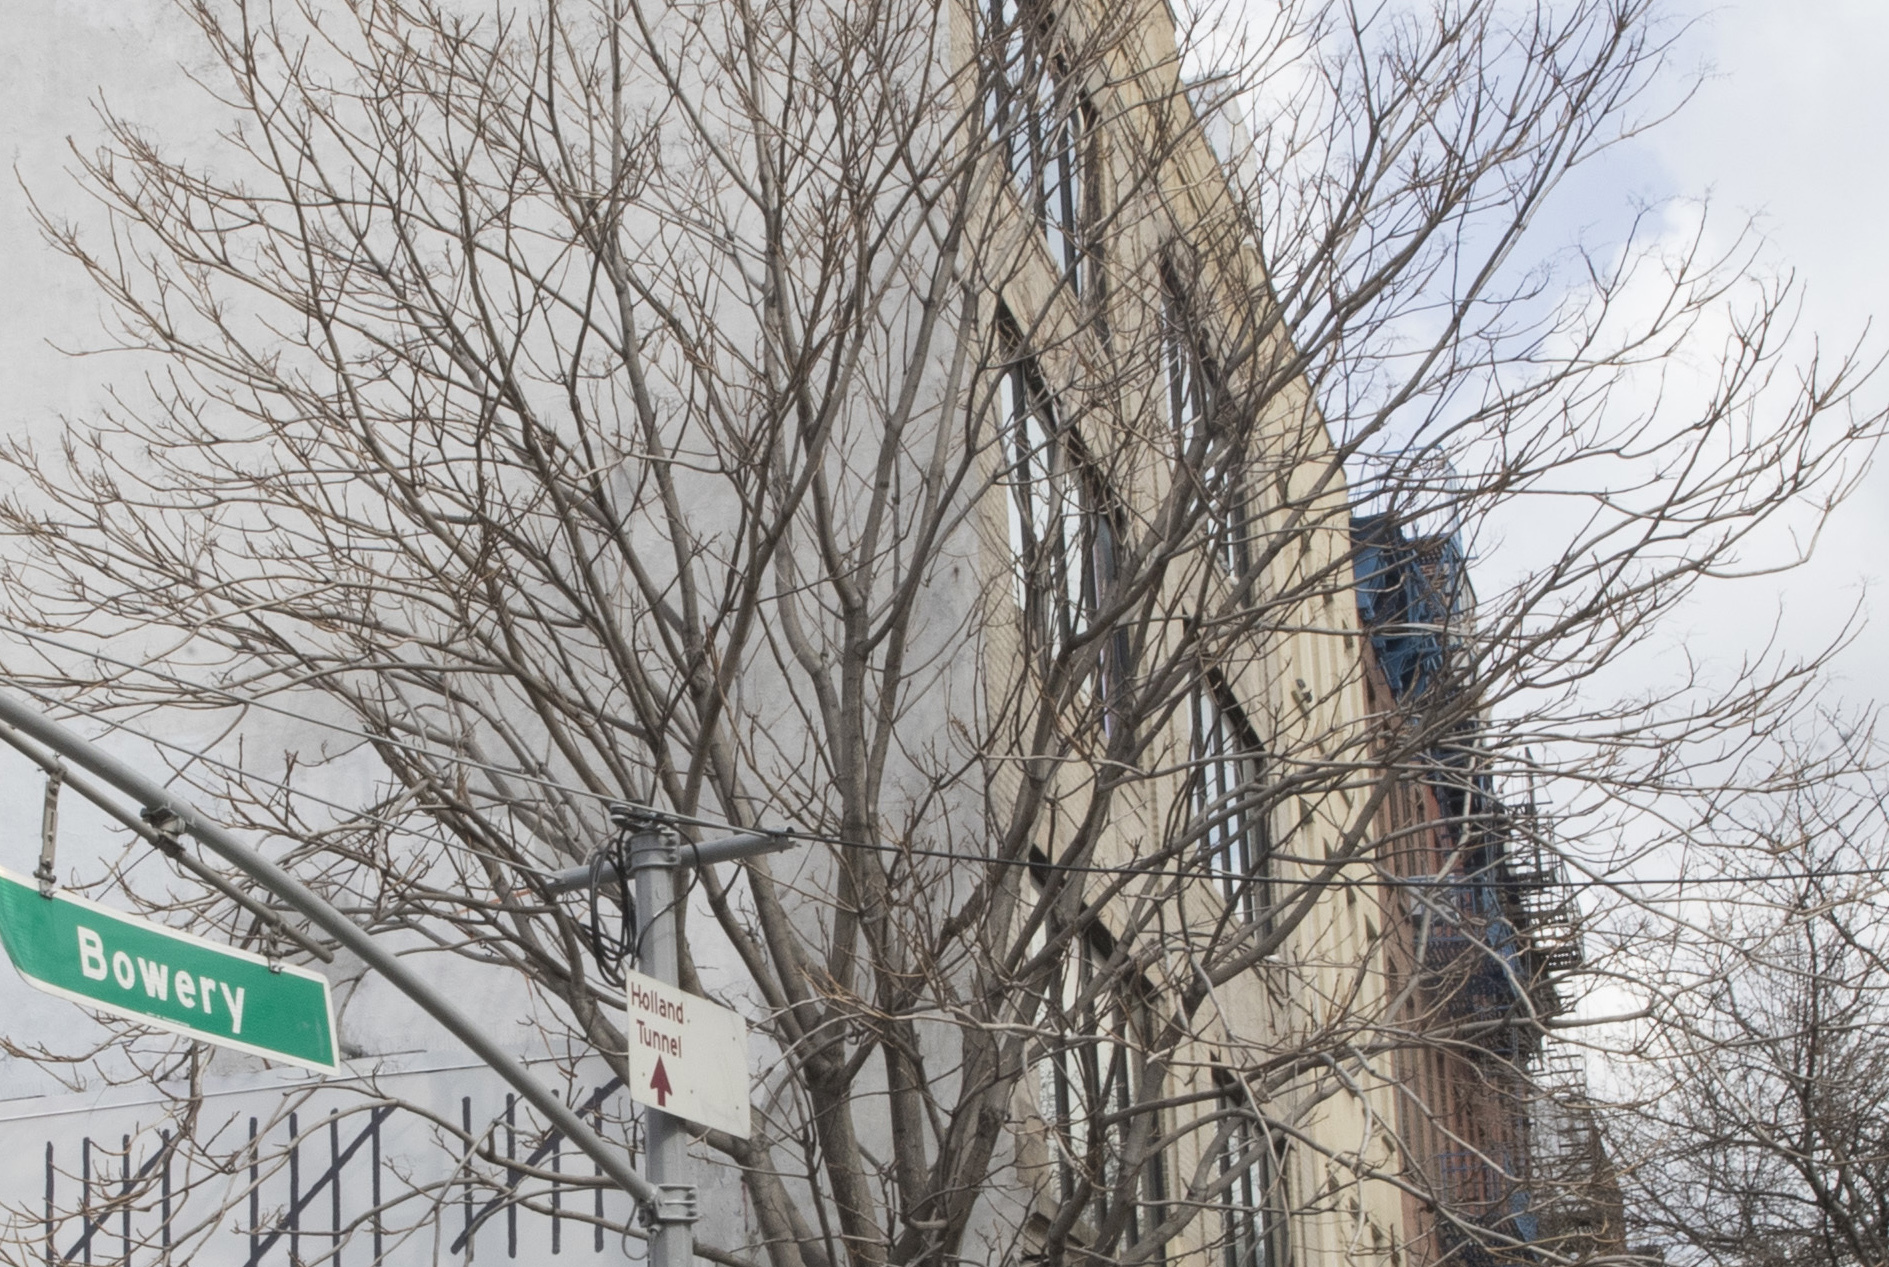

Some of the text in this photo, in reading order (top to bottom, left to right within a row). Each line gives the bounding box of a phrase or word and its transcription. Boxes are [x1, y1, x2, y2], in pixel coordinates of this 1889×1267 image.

[76, 925, 246, 1035] Bowery
[631, 982, 684, 1025] Holland
[636, 1020, 682, 1058] Tunnel
